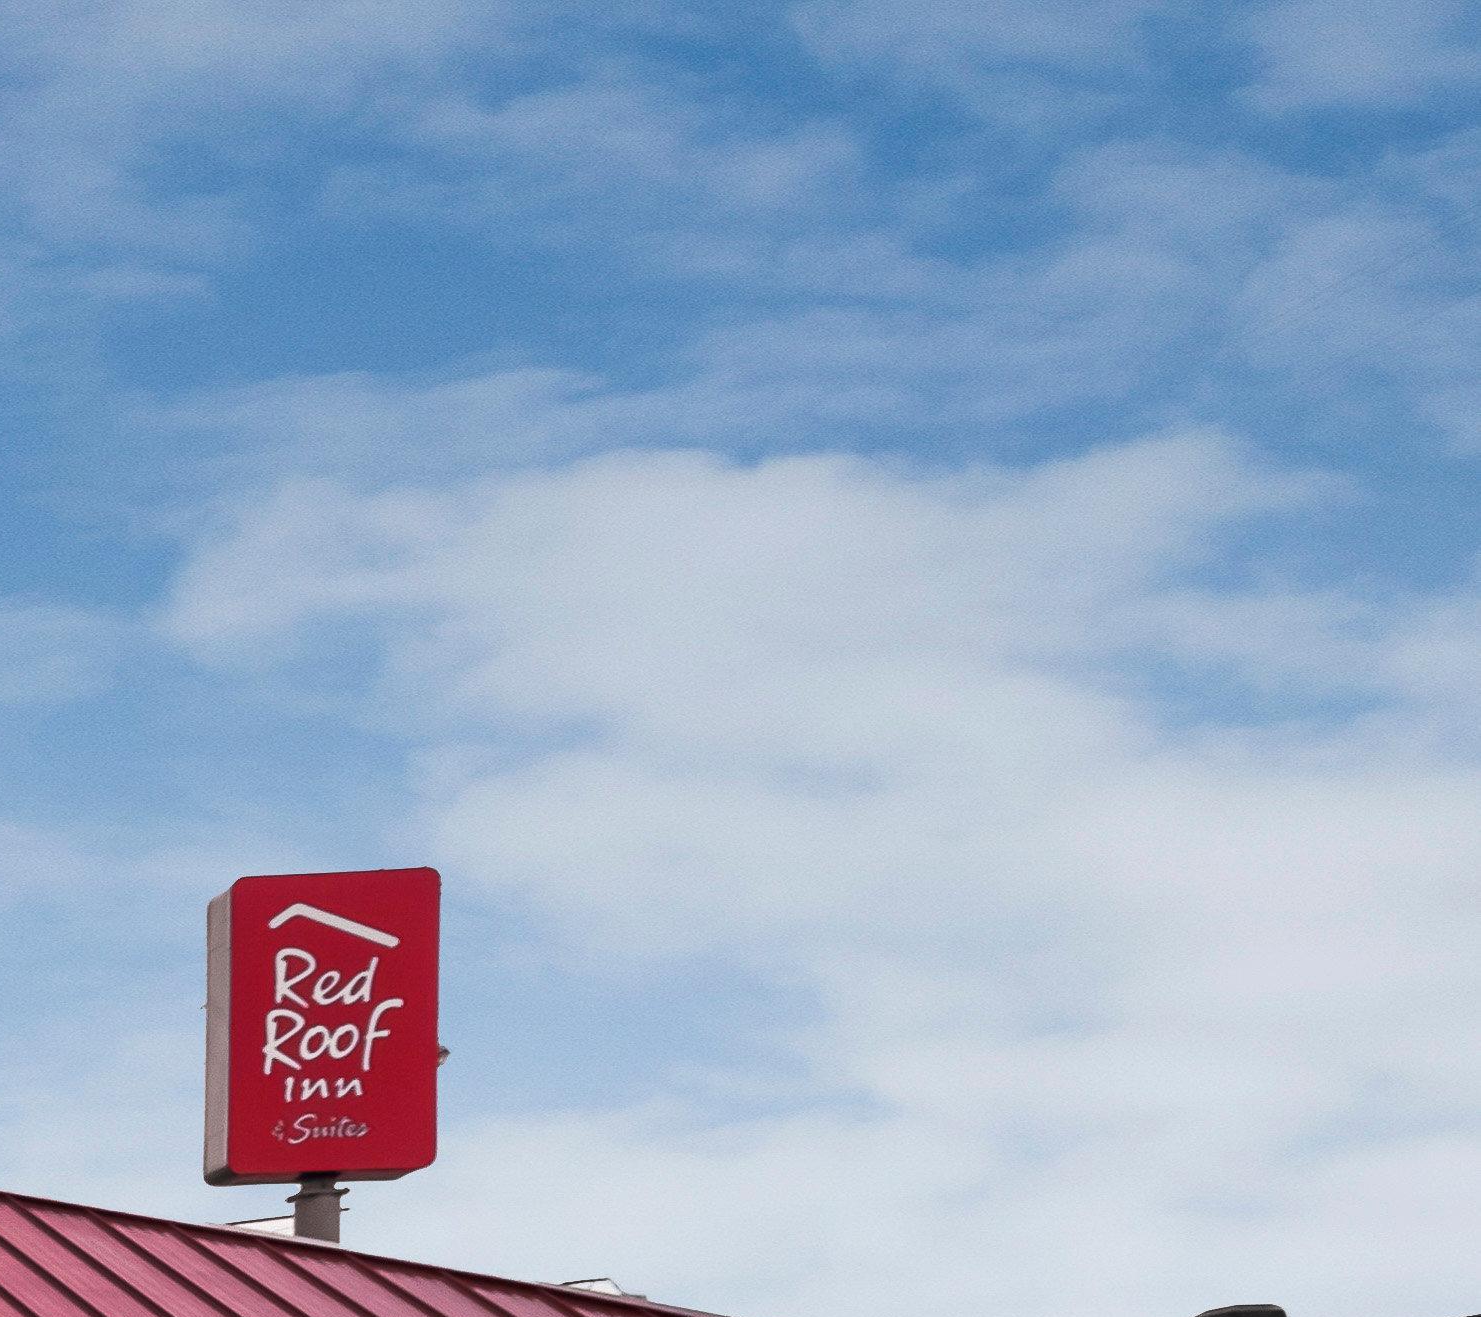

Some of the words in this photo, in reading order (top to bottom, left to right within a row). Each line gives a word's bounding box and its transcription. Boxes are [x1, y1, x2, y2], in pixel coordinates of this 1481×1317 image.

[274, 947, 379, 1009] Red
[262, 998, 404, 1075] Roof
[287, 1112, 370, 1144] Suites
